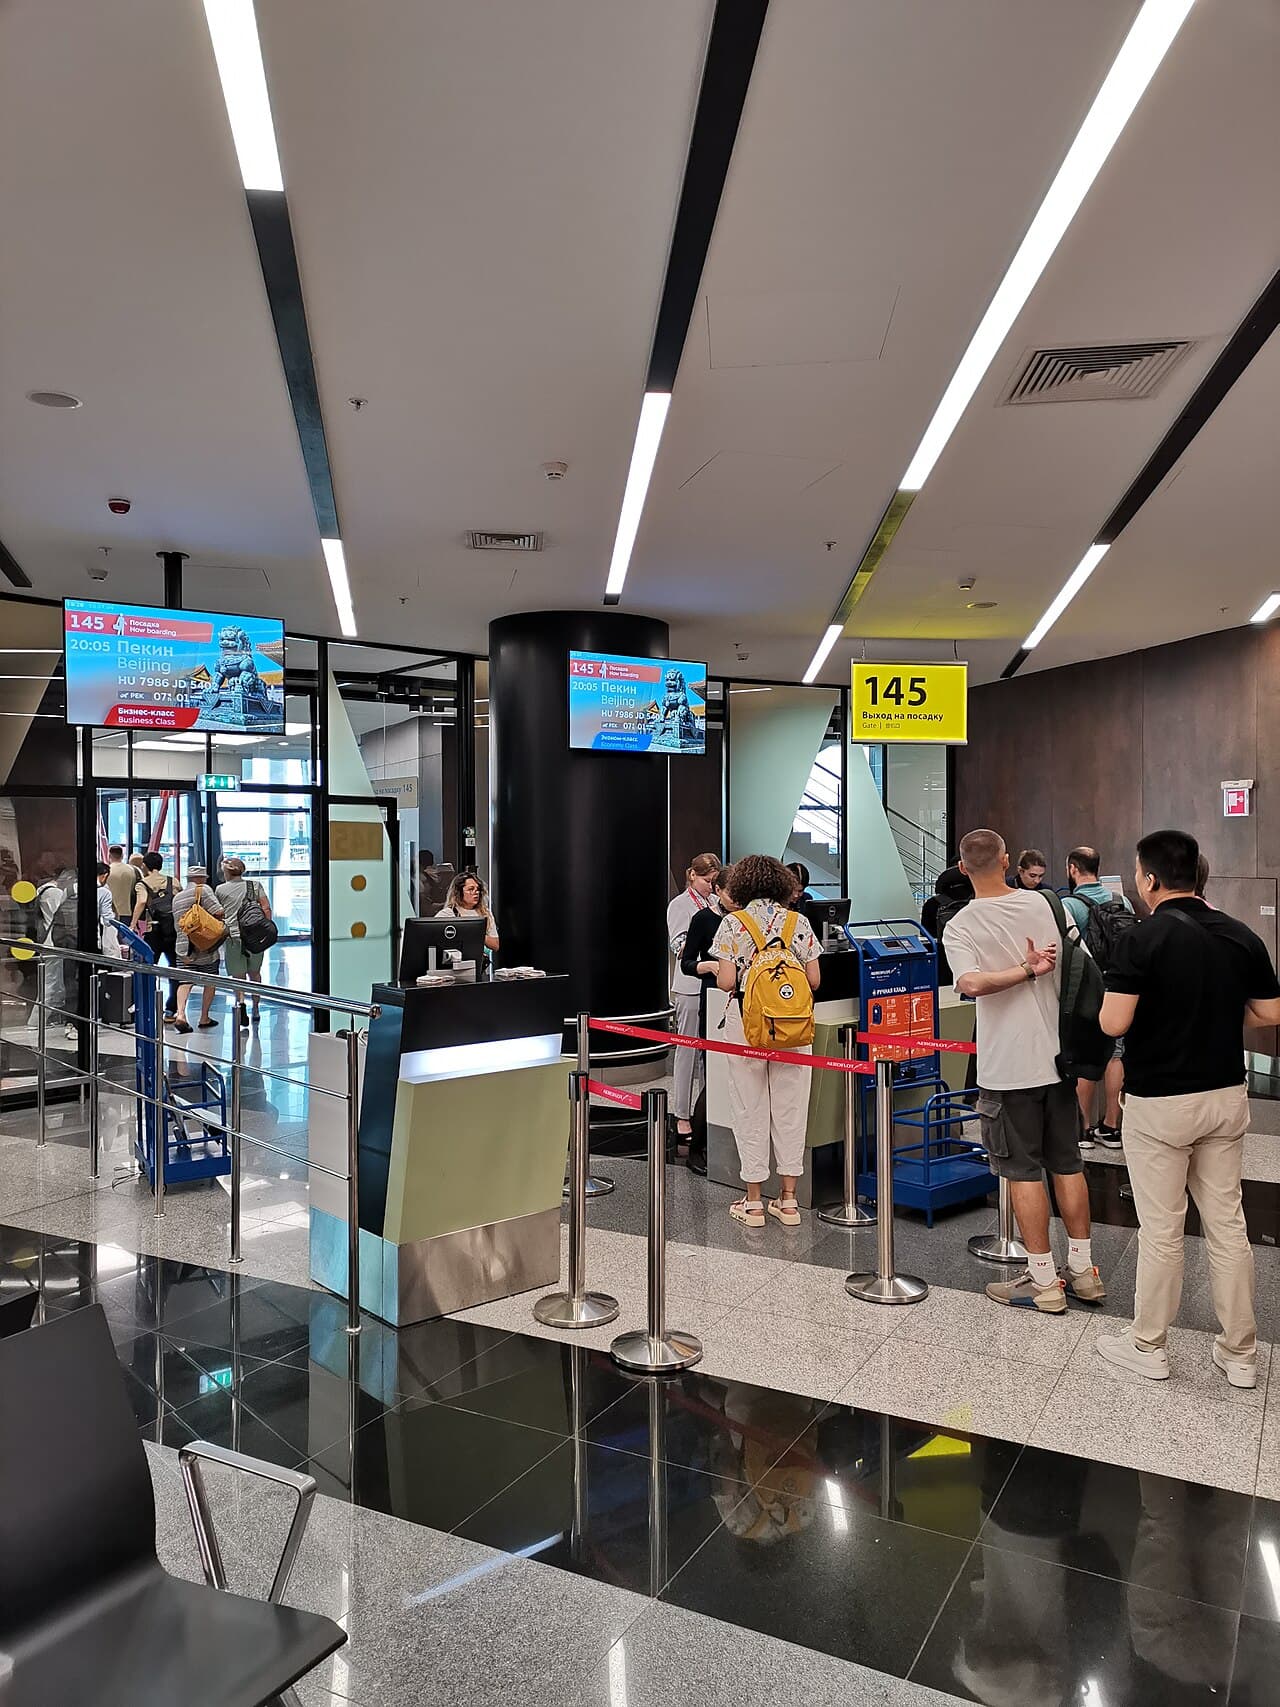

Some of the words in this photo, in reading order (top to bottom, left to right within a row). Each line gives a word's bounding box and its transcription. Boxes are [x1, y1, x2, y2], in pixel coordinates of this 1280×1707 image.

[70, 614, 104, 630] 145
[129, 619, 160, 628] Посадка
[147, 627, 177, 637] boarding
[70, 639, 111, 652] 20:05
[117, 641, 174, 657] Пекин
[117, 657, 172, 675] Beijing
[572, 662, 594, 674] 145
[118, 676, 136, 685] HU
[139, 677, 170, 688] 7986
[171, 680, 187, 689] JD
[572, 681, 598, 691] 20:05
[601, 682, 637, 694] Пекин
[865, 676, 927, 706] 145
[601, 695, 635, 708] Beijing
[118, 707, 175, 717] Бизнес-класс
[862, 711, 893, 720] Выход
[907, 713, 944, 722] посадку
[118, 716, 154, 725] Business
[155, 717, 176, 726] Class
[916, 1041, 949, 1049] AEROFLOT
[826, 1061, 855, 1069] AEROFLOT
